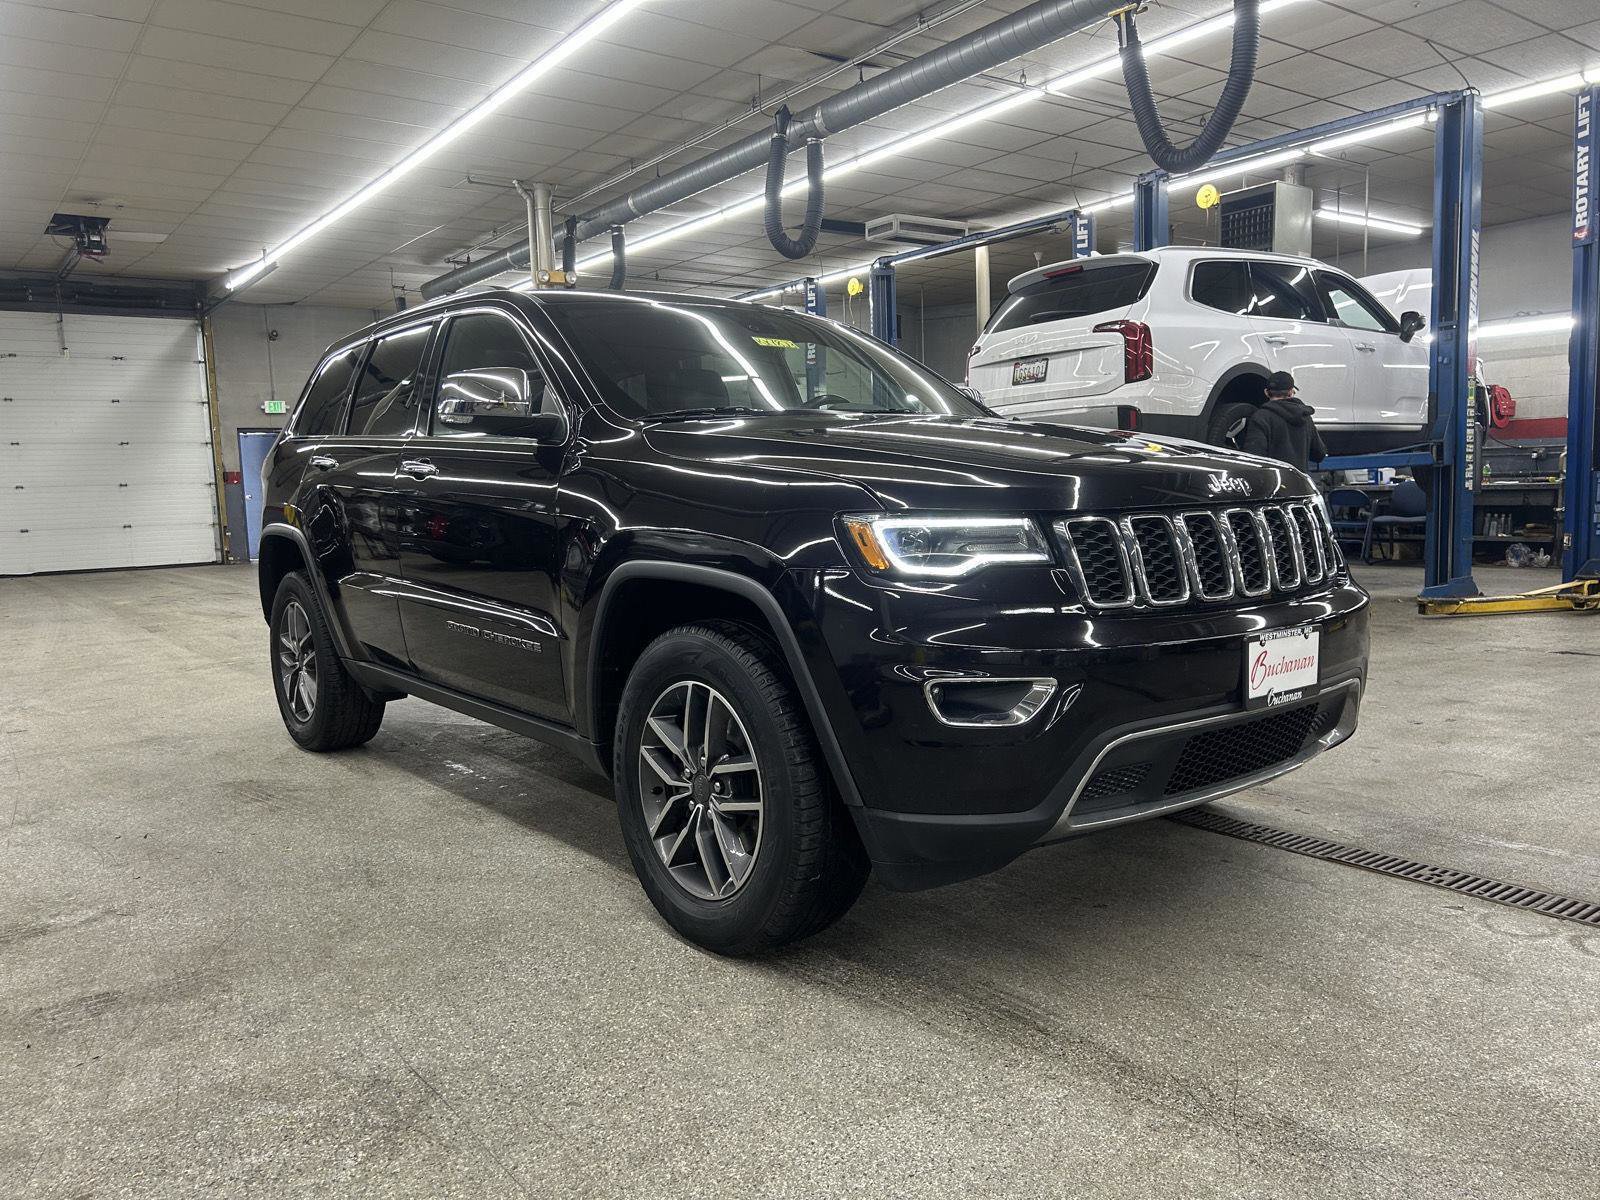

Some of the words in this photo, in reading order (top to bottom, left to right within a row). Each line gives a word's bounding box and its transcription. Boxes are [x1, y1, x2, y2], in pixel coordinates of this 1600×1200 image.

[1578, 95, 1590, 139] LIFT
[1576, 145, 1589, 228] ROTARY
[1076, 217, 1088, 249] LIFT
[807, 283, 816, 307] LIFT
[268, 401, 283, 412] EXIT
[1208, 473, 1252, 497] Jeep
[1251, 650, 1314, 690] Buchanan
